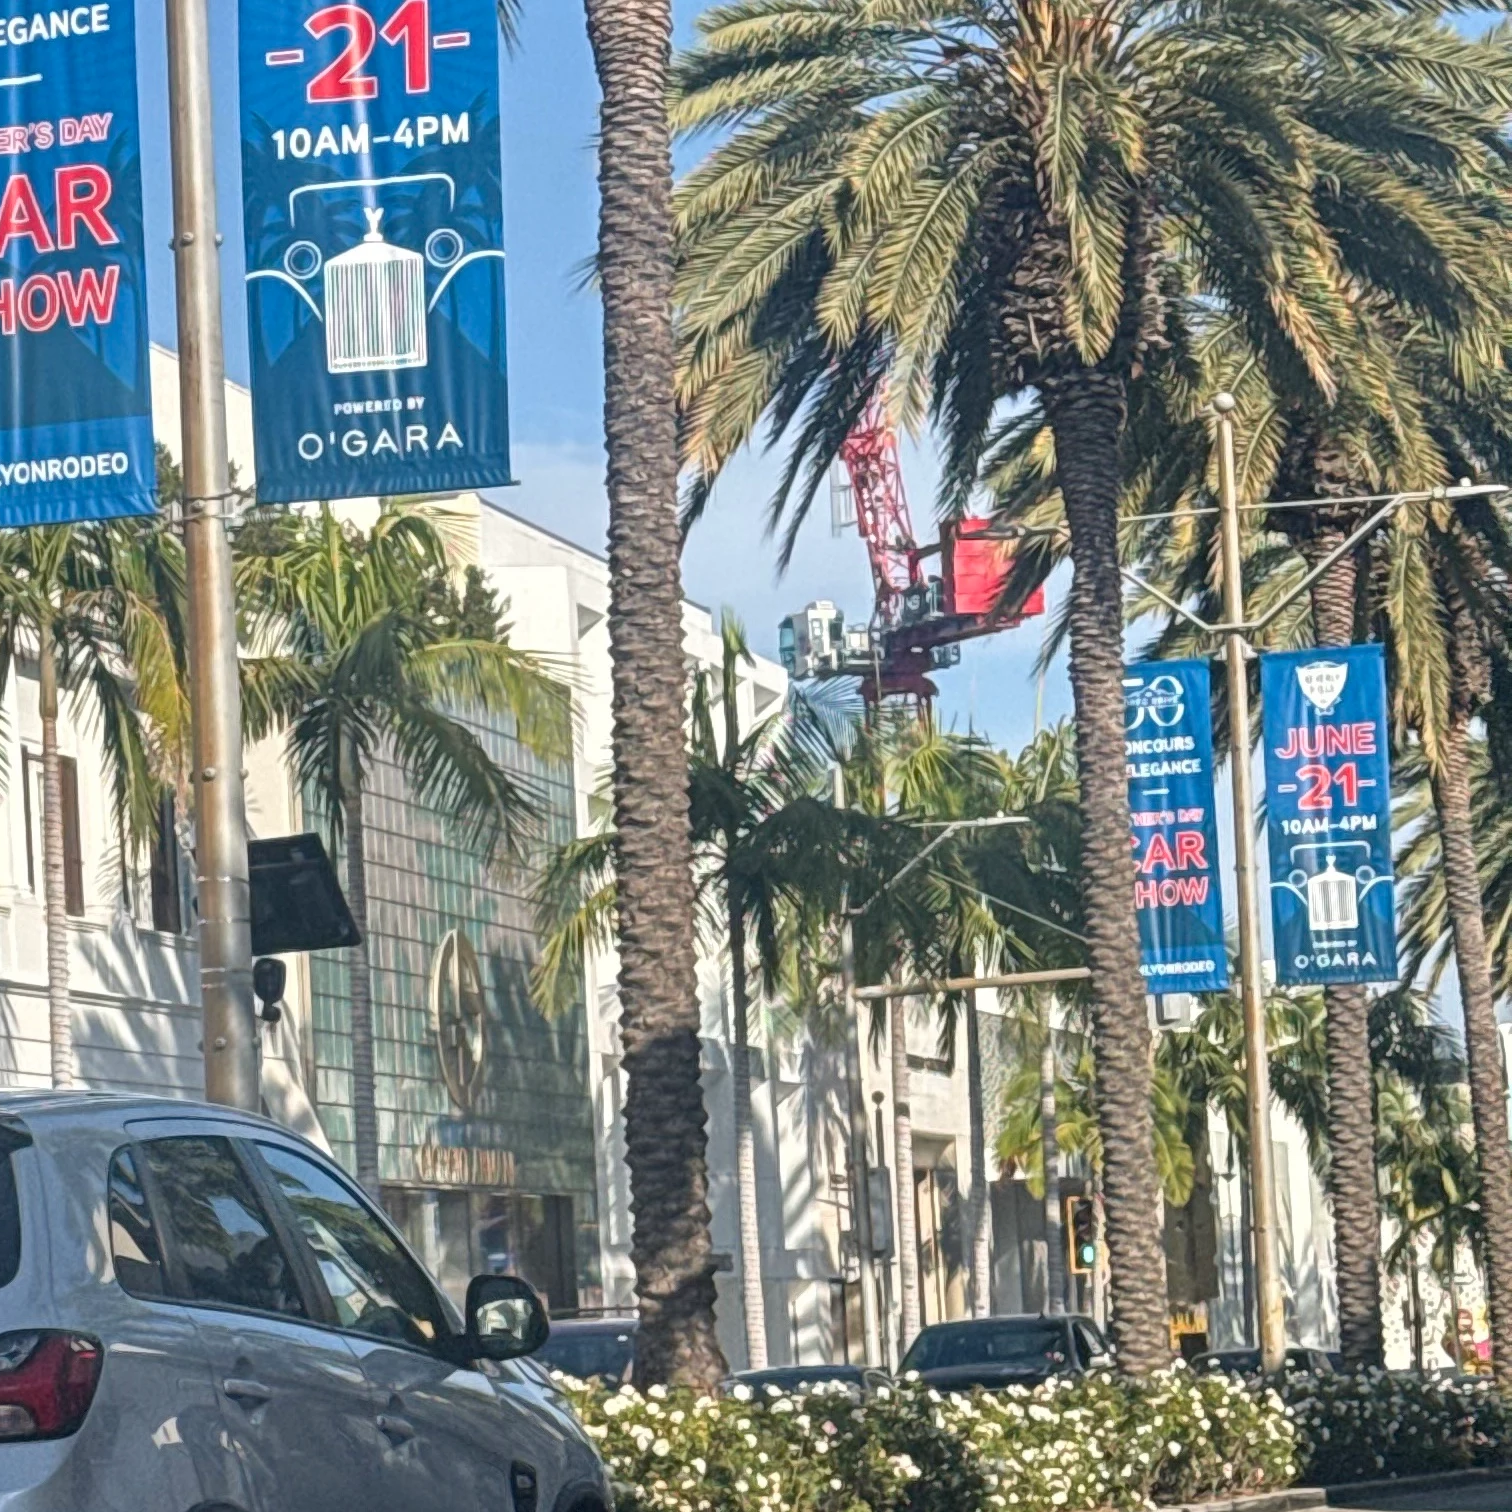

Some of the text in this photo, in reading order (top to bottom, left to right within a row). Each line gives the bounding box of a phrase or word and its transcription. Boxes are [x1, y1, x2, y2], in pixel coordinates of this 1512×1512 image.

[59, 112, 114, 146] DAY
[334, 396, 426, 416] POWERED BY
[298, 421, 464, 460] O'GARA
[1124, 735, 1195, 756] ONCOURS
[1274, 722, 1376, 759] JUNE
[1130, 831, 1209, 873] AR
[1135, 876, 1209, 909] HOW
[1294, 951, 1377, 969] O'GARA
